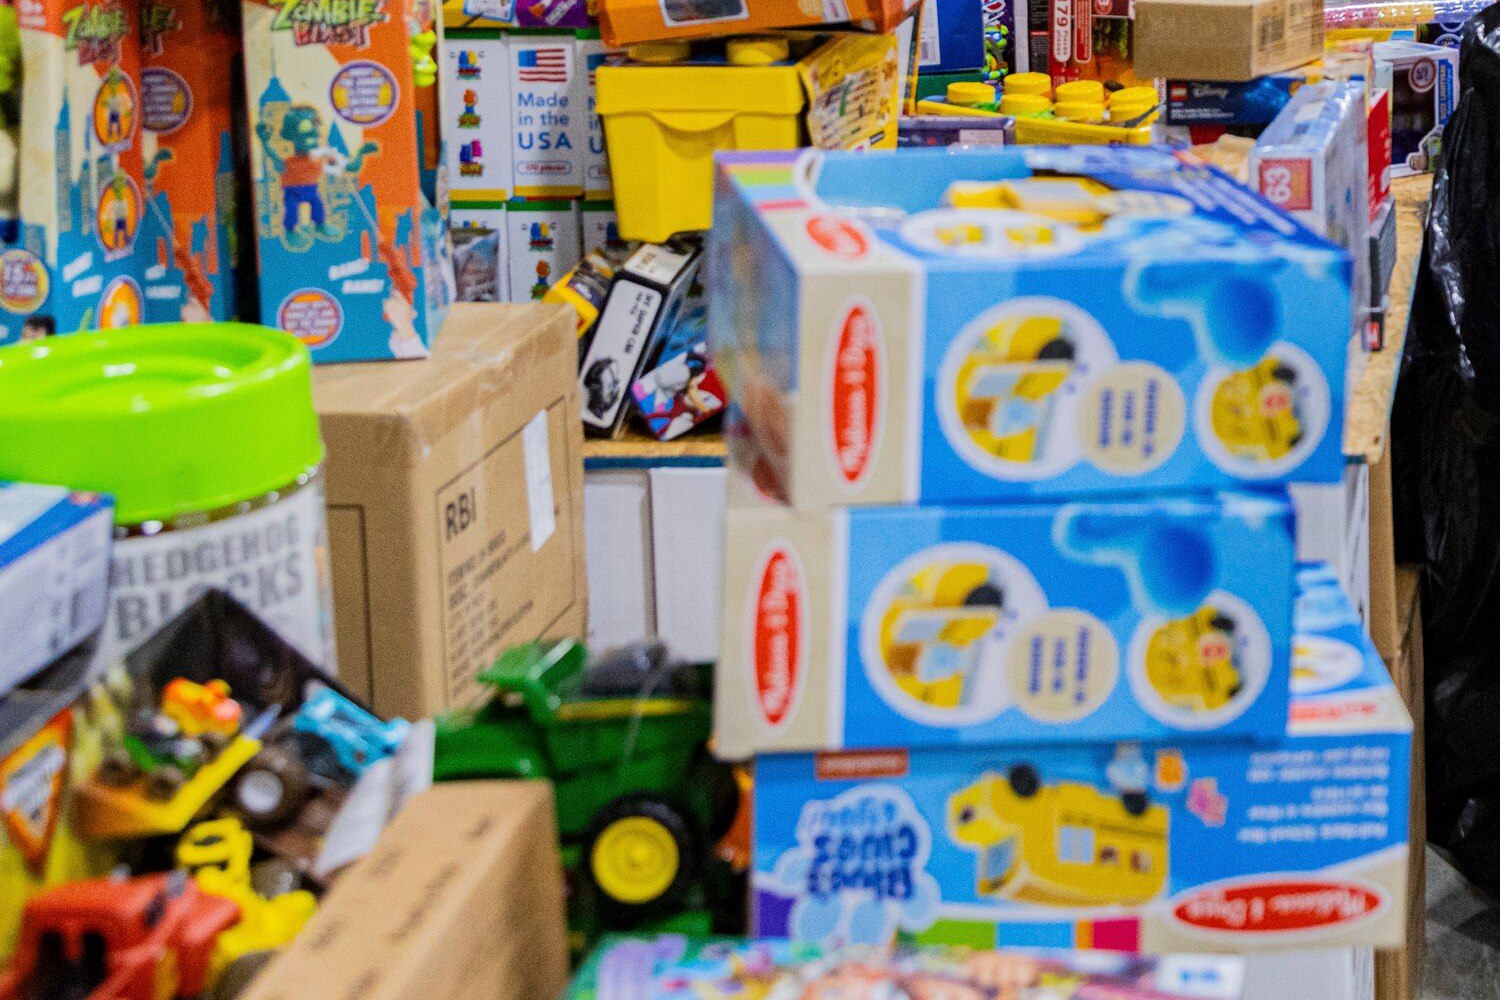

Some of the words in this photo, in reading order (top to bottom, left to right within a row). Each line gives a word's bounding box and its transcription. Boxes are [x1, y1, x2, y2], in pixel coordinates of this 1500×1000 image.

[518, 92, 570, 107] Made
[518, 112, 536, 126] in
[539, 111, 570, 126] the
[518, 132, 573, 150] USA
[1263, 166, 1292, 203] 63
[445, 487, 476, 544] RBI
